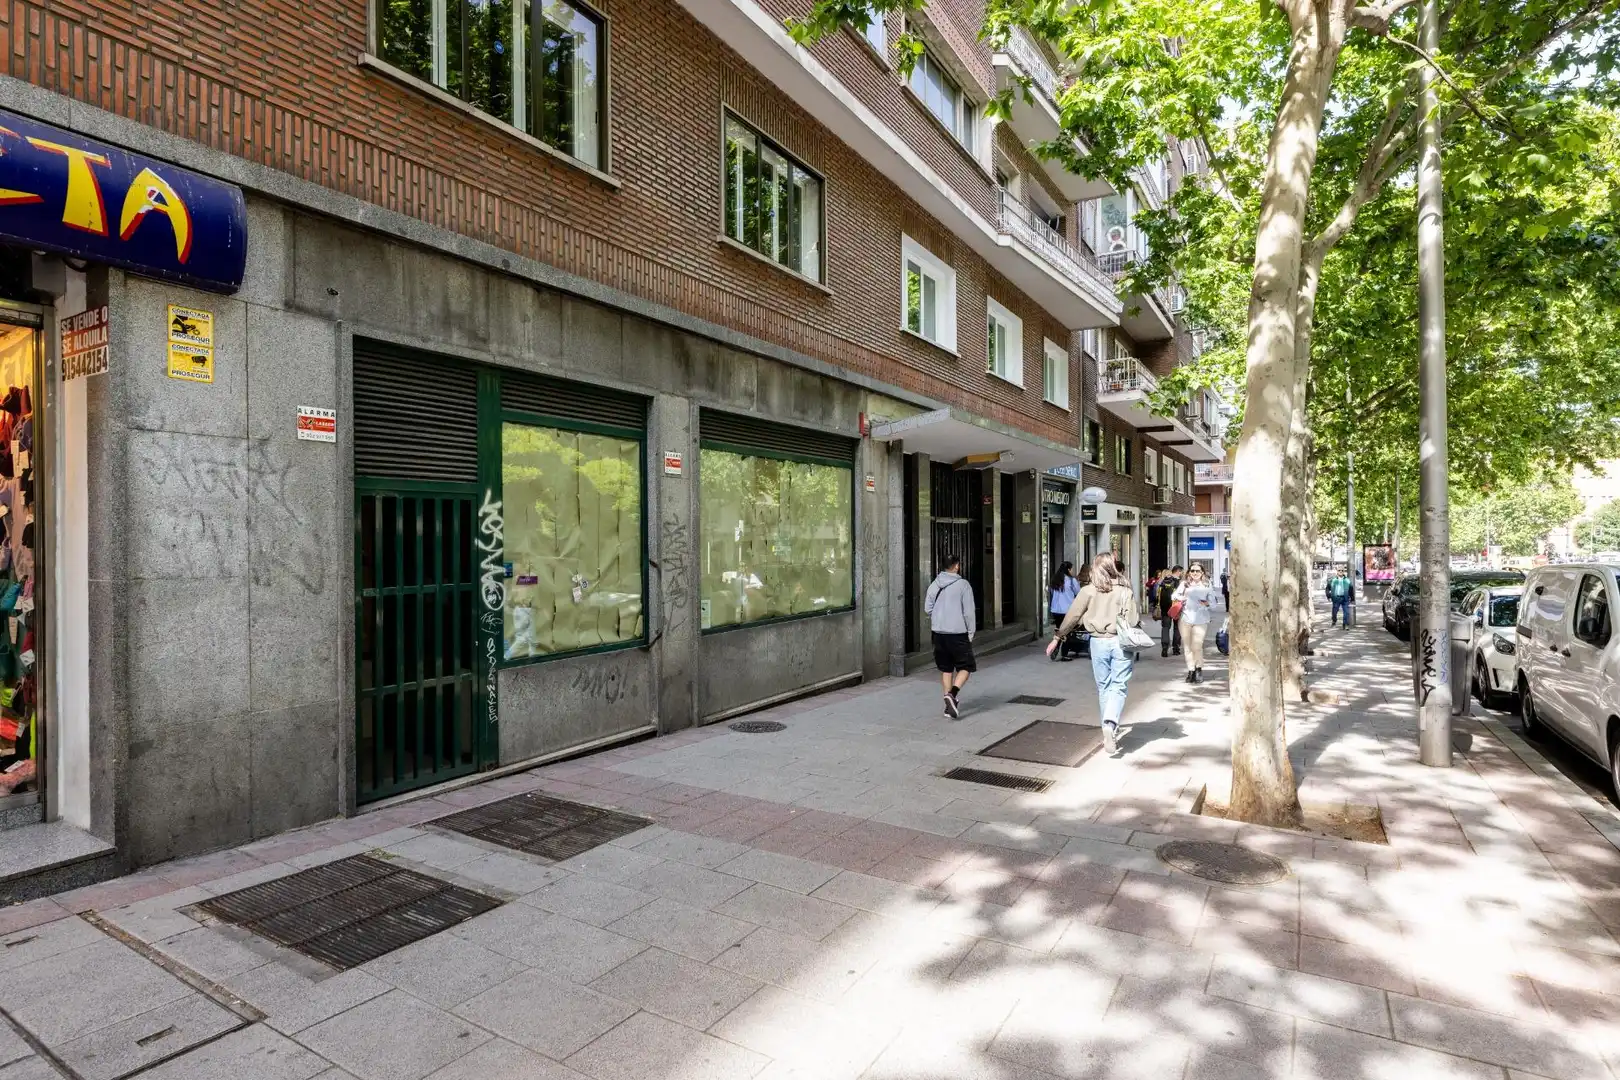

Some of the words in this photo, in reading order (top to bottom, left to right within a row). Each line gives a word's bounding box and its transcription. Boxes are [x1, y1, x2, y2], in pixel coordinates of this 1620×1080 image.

[172, 307, 210, 320] CONECTADA
[61, 318, 72, 336] SE
[73, 308, 100, 332] VENDE
[101, 305, 108, 323] O
[62, 336, 72, 355] SE
[73, 325, 108, 351] ALQUILA
[172, 332, 210, 345] PROSEGUR
[172, 344, 210, 355] CONECTADA
[62, 346, 108, 382] 915442154
[172, 369, 210, 380] PROSEGUR
[298, 407, 335, 418] ALARMA
